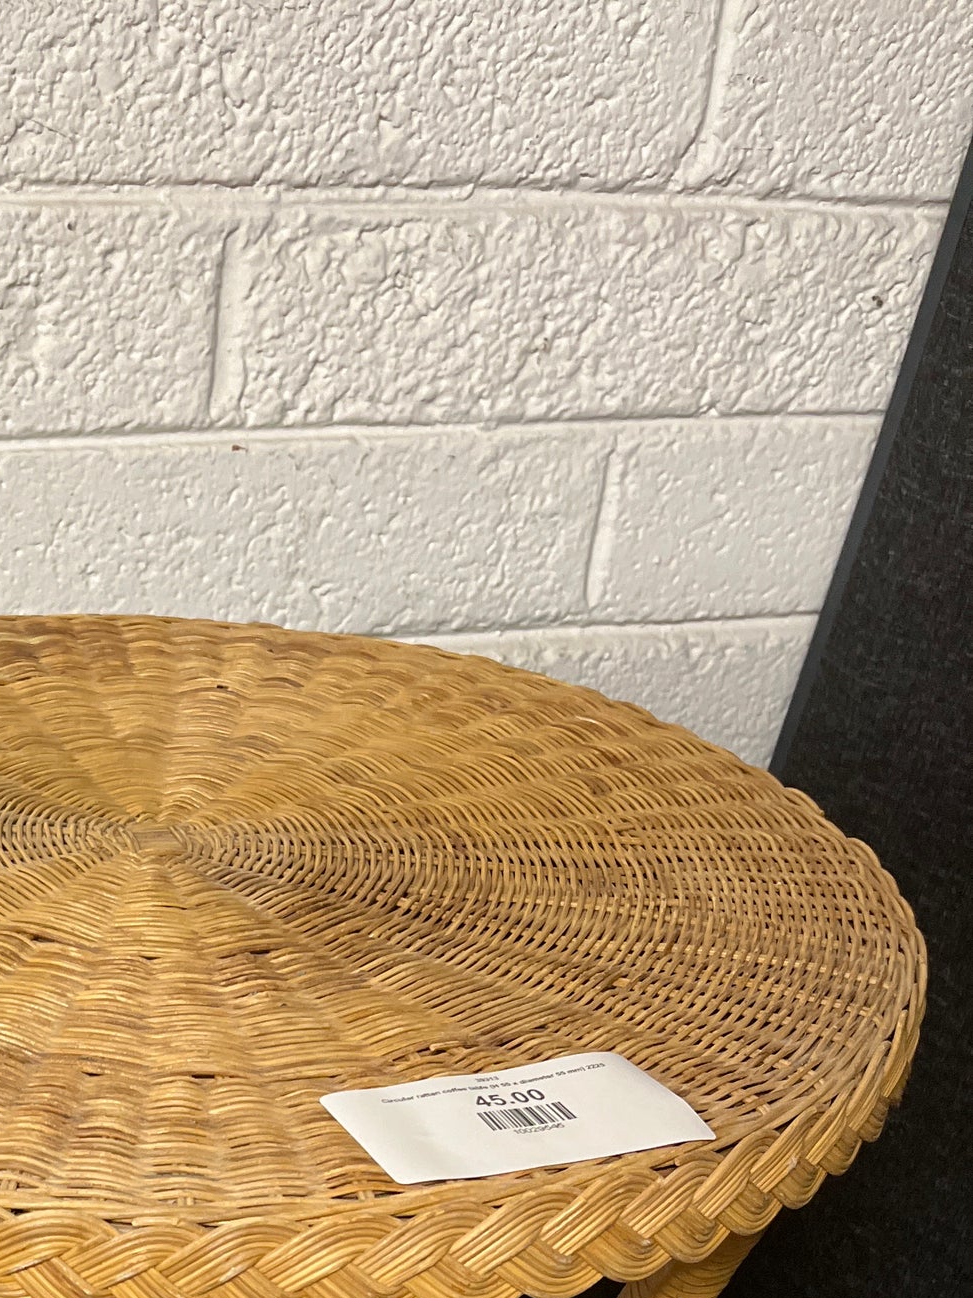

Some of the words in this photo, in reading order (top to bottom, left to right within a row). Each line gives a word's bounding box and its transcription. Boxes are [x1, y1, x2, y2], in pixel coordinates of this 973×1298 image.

[381, 1095, 414, 1104] Circular
[416, 1090, 441, 1099] rattan
[519, 1073, 554, 1084] diameter
[567, 1066, 586, 1074] mm)
[475, 1088, 546, 1107] 45.00
